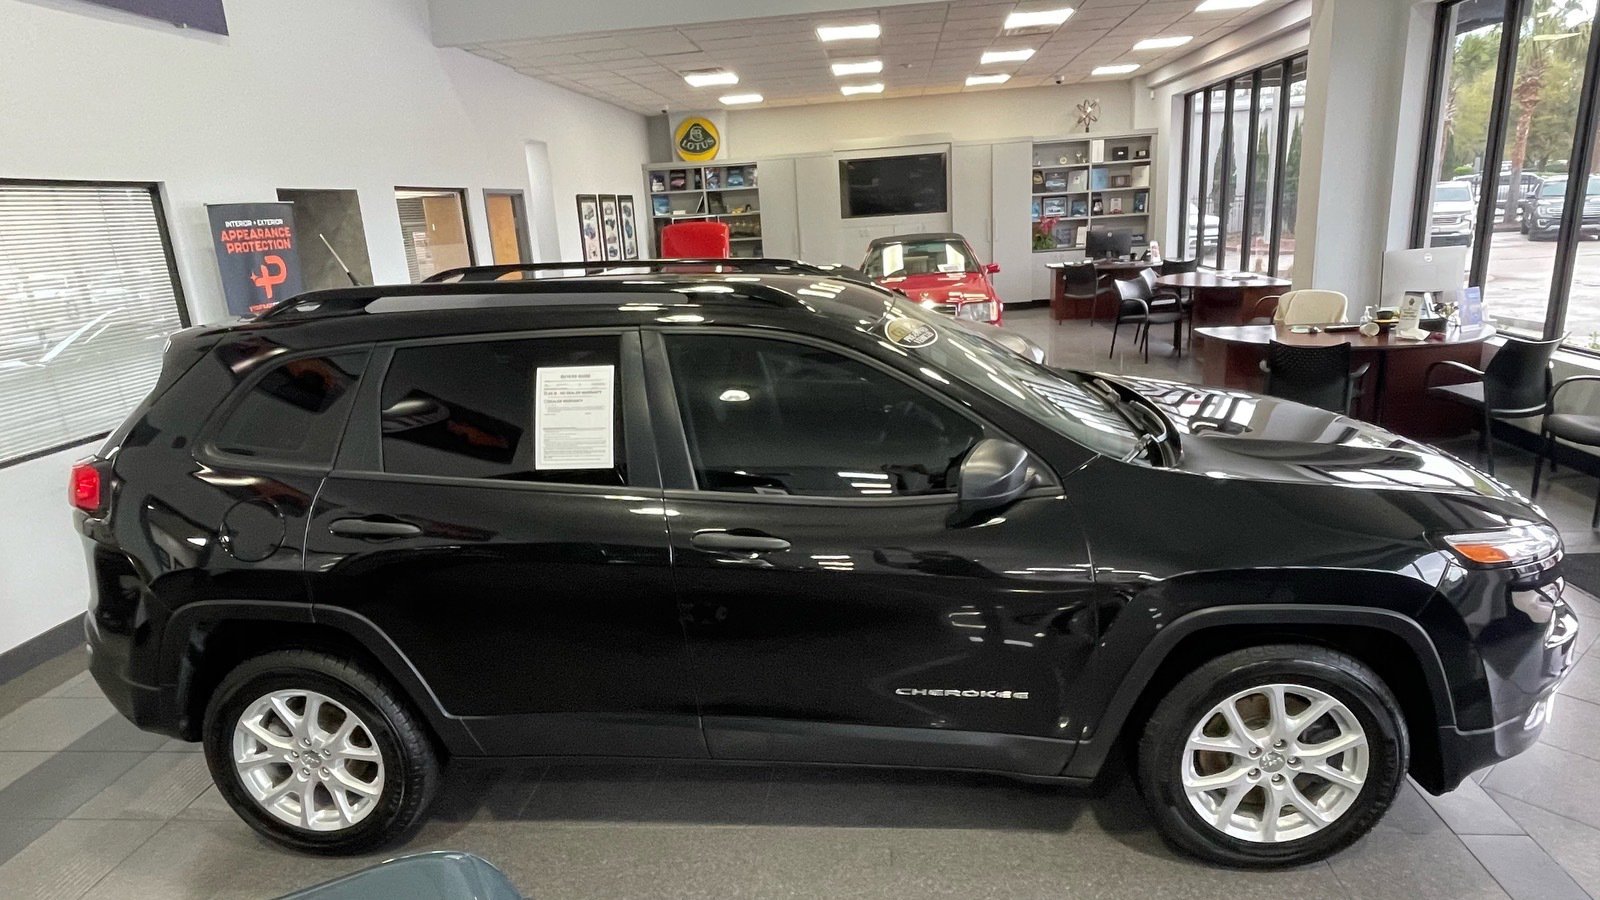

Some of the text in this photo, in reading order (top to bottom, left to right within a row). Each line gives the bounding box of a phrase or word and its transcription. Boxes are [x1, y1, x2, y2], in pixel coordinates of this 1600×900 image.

[681, 138, 715, 151] LOTUS
[224, 220, 252, 228] INTERIOR
[257, 218, 284, 226] EXTERIOR
[221, 227, 292, 242] APPEARANCE
[226, 238, 292, 254] PROTECTION
[895, 688, 1029, 700] CHEROKEE
